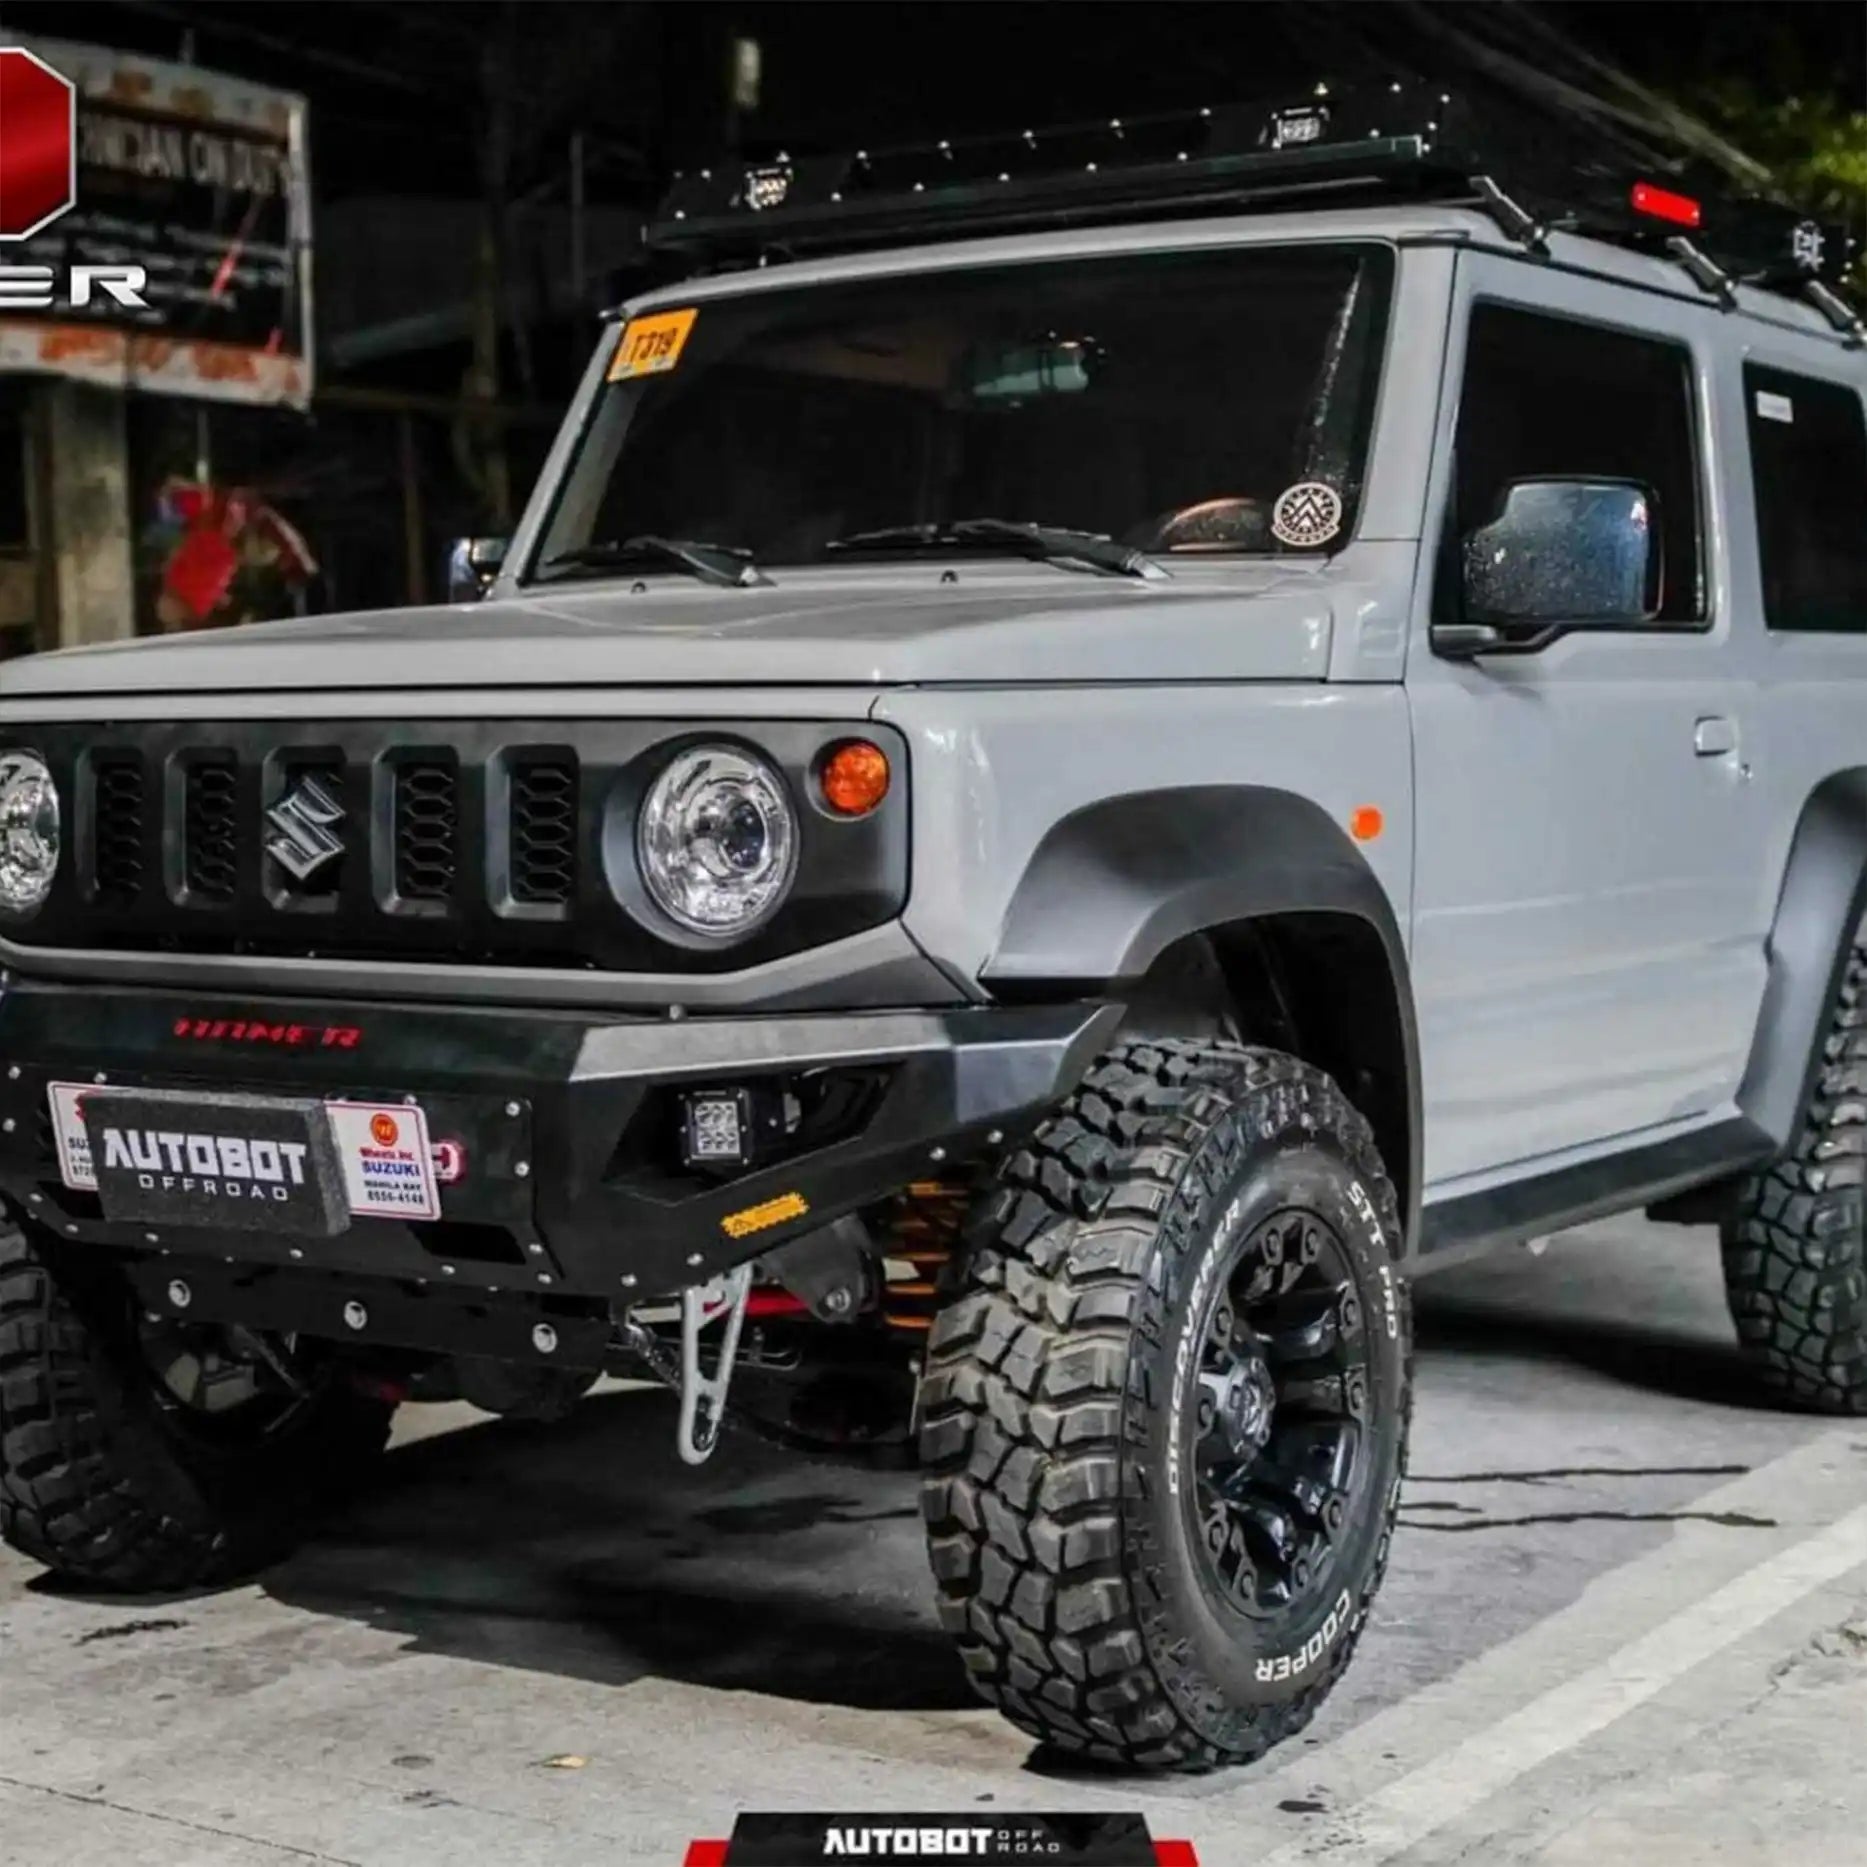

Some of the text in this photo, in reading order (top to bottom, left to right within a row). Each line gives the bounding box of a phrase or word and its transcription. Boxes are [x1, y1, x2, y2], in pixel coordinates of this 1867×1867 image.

[103, 1127, 307, 1185] AUTOBOT
[362, 1160, 421, 1177] SUZUKI
[138, 1173, 289, 1202] OFFROAD
[1345, 1180, 1387, 1248] STT
[1254, 1587, 1351, 1682] COOPER
